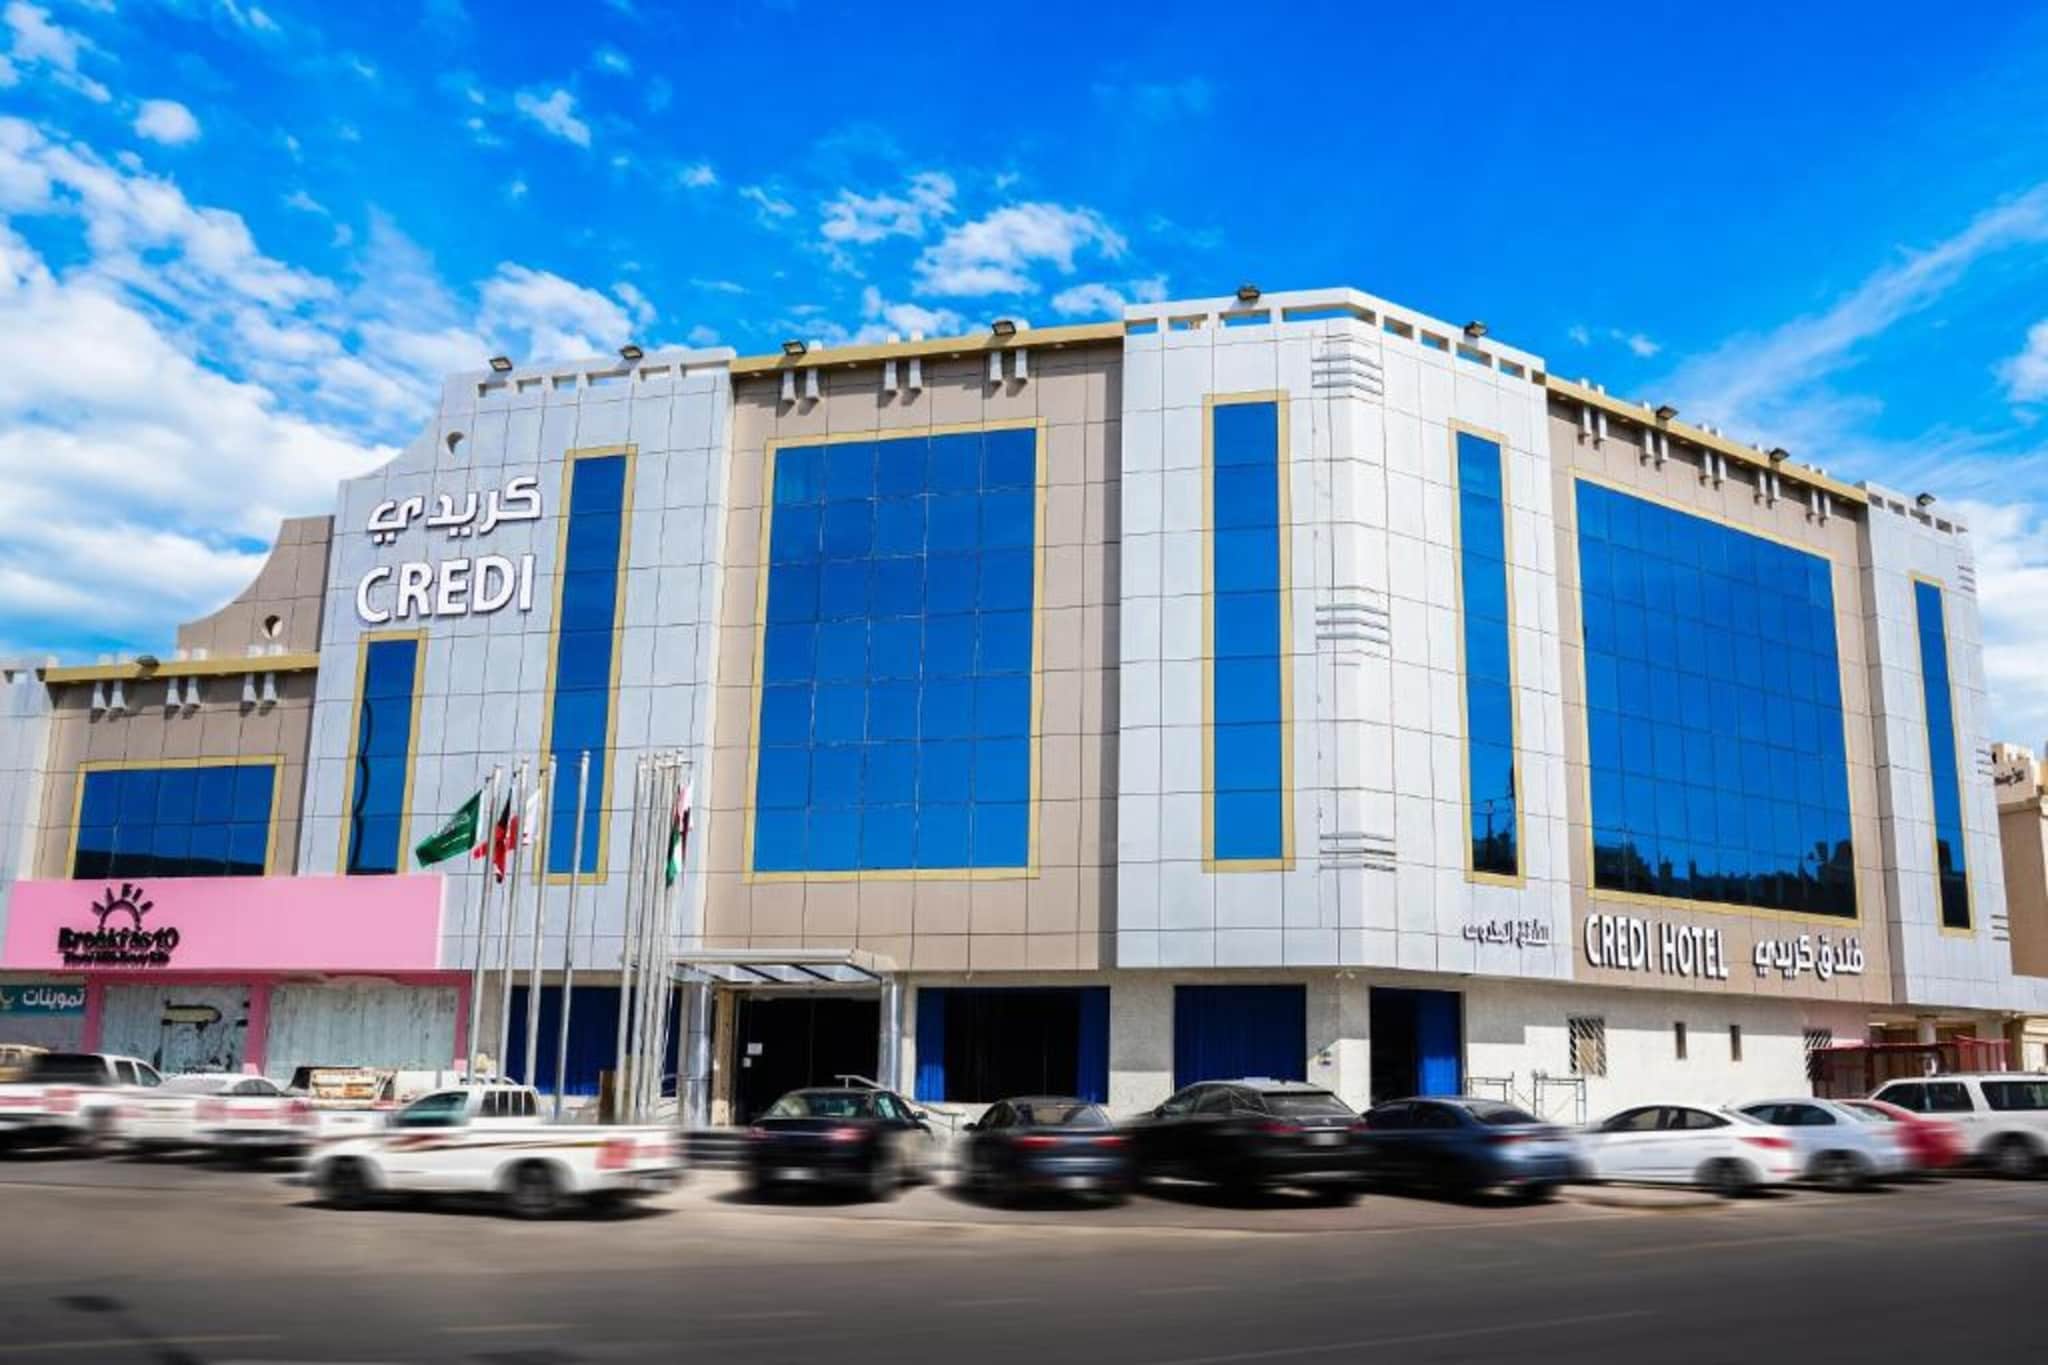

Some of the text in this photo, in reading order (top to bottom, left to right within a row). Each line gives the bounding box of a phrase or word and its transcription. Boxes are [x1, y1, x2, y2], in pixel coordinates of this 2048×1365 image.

[367, 475, 542, 545] كريدي
[356, 552, 537, 624] CREDI
[1585, 913, 1653, 971] CREDI
[1659, 922, 1729, 981] HOTEL
[1753, 934, 1865, 982] فندق كريدي
[23, 987, 86, 1010] تموينات
